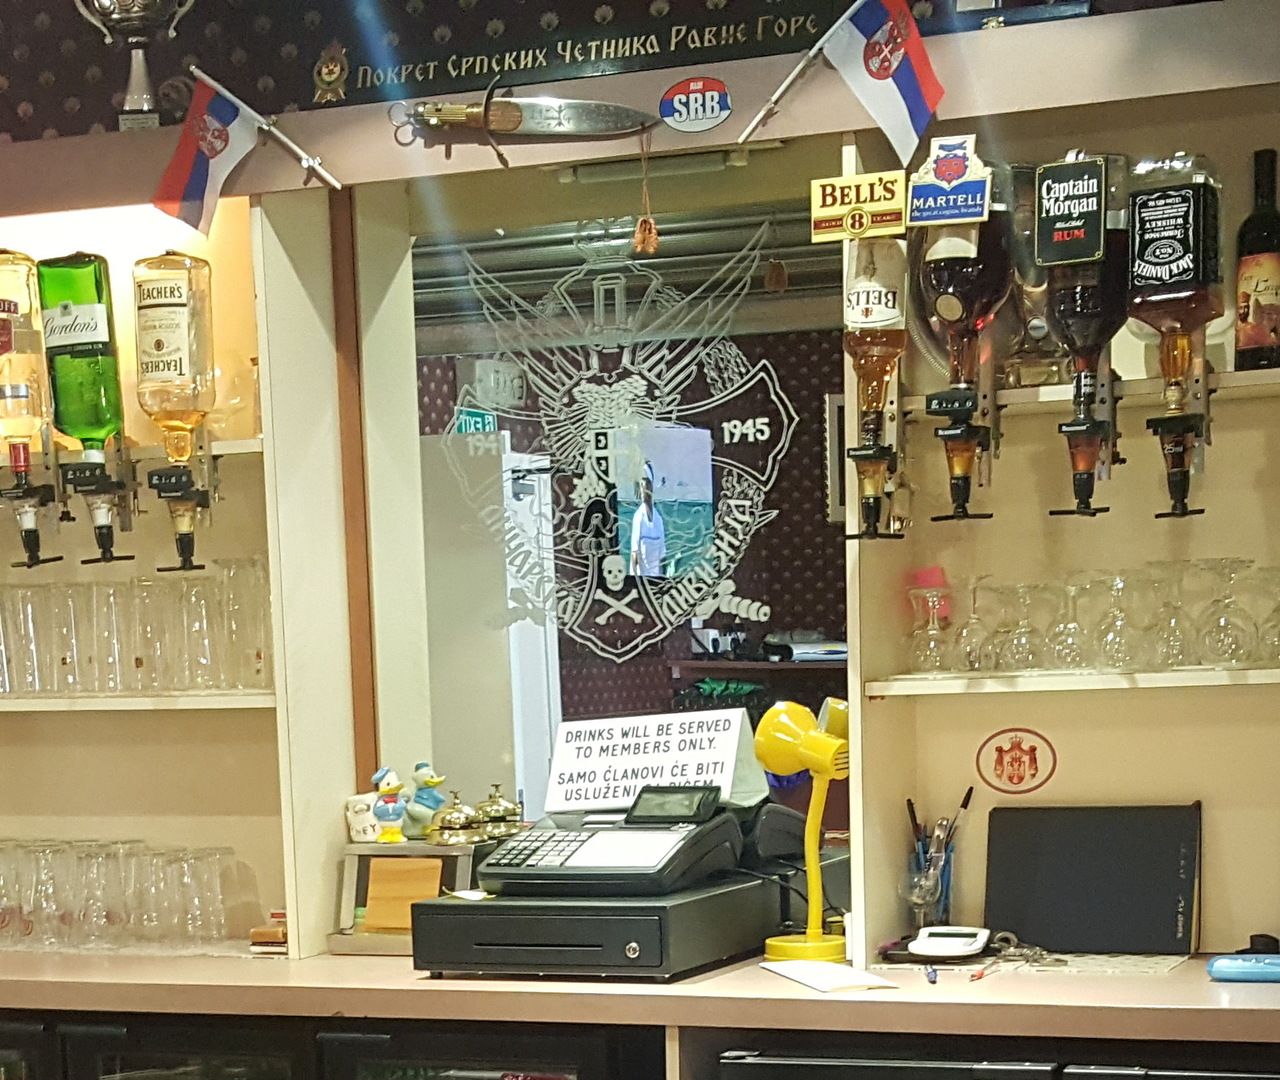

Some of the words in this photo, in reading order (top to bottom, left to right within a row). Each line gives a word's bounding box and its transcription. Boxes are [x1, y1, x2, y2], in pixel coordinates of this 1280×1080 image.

[673, 90, 721, 122] SRB
[819, 177, 898, 209] BELL'S
[1041, 175, 1098, 201] Captain
[912, 193, 984, 210] MARTELL
[1041, 196, 1098, 218] Morgan
[850, 212, 865, 230] 8
[1053, 228, 1087, 243] RUM
[1169, 253, 1195, 276] JACK
[137, 282, 183, 304] TEACHER'S
[44, 315, 99, 340] Gordon's
[721, 417, 771, 445] 1945
[565, 728, 614, 744] DRINKS
[621, 725, 650, 739] WILL
[656, 723, 674, 737] BE
[678, 718, 732, 735] SERVED
[575, 745, 592, 760] TO
[598, 740, 671, 758] MEMBERS
[678, 737, 717, 752] ONLY.
[557, 770, 596, 785] SAMO
[696, 761, 725, 776] BITI
